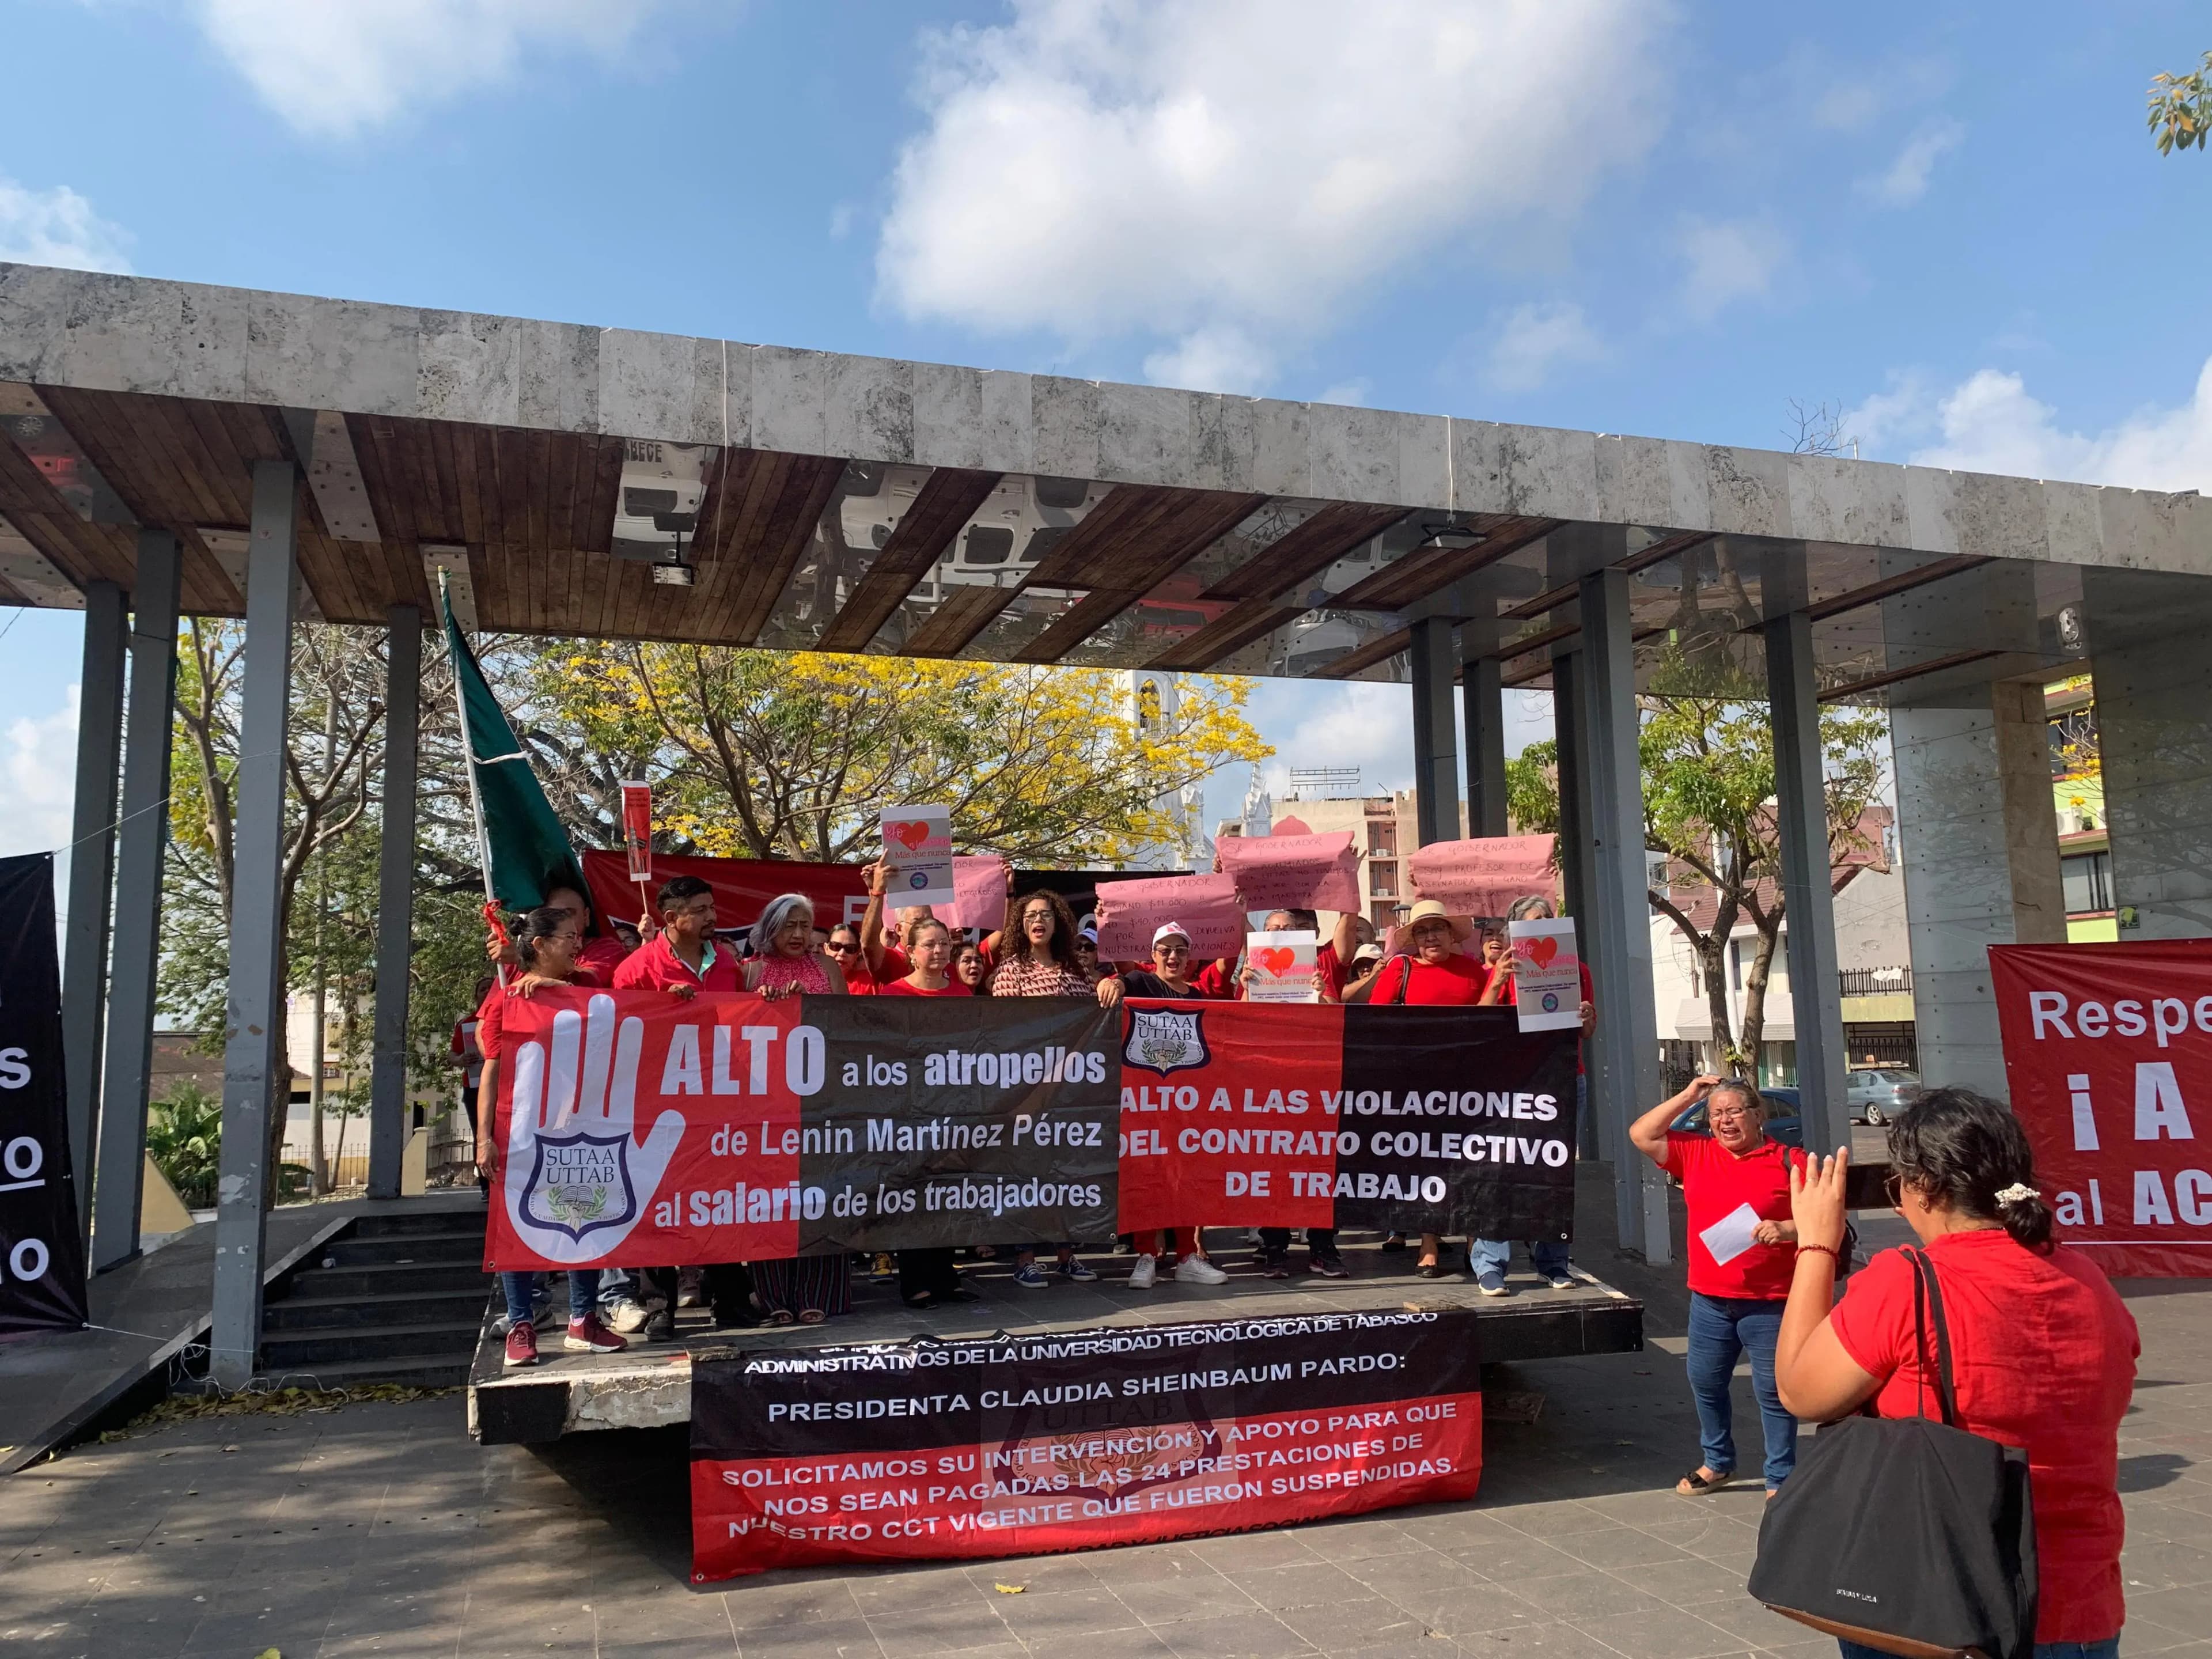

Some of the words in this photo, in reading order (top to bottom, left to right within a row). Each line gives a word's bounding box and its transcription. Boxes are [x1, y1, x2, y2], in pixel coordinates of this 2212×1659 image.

[912, 851, 925, 859] que
[1255, 837, 1322, 855] GOBERNADOR
[1448, 841, 1527, 855] GOBERNADOR
[1455, 863, 1508, 874] PROFESOR
[1520, 862, 1536, 870] DE
[1137, 878, 1213, 893] GOBERNADOR
[1116, 933, 1135, 942] POR
[1105, 944, 1153, 955] NUESTRAS
[1190, 941, 1236, 952] TACIONES
[1260, 978, 1276, 986] Más
[1527, 969, 1541, 978] Más
[1543, 969, 1556, 979] que
[1138, 1015, 1194, 1028] SUTAA
[1138, 1027, 1192, 1040] UTTAB
[660, 1024, 825, 1096] ALTO
[842, 1062, 859, 1086] a
[867, 1054, 908, 1086] los
[925, 1046, 1105, 1089] atropellos
[1120, 1085, 1199, 1113] ALTO
[1209, 1086, 1233, 1112] A
[1243, 1088, 1309, 1114] LAS
[1320, 1090, 1558, 1122] VIOLACIONES
[711, 1123, 748, 1156] de
[761, 1119, 853, 1155] Lenin
[867, 1116, 1004, 1152] Martínez
[1013, 1113, 1102, 1147] Pérez
[1178, 1127, 1361, 1156] CONTRATO
[1370, 1131, 1569, 1168] COLECTIVO
[546, 1148, 616, 1166] SUTAA
[546, 1166, 614, 1184] UTTAB
[1225, 1171, 1271, 1198] DE
[1289, 1171, 1446, 1204] TRABAJO
[654, 1192, 680, 1228] al
[688, 1182, 825, 1226] salario
[832, 1184, 867, 1218] de
[876, 1184, 916, 1215] los
[925, 1177, 1101, 1217] trabajadores
[2055, 1179, 2104, 1226] al
[745, 1349, 950, 1374] ADMINISTRATIVOS
[954, 1349, 986, 1365] DE
[989, 1347, 1018, 1363] LA
[1021, 1334, 1162, 1361] UNIVERSIDAD
[1314, 1318, 1341, 1333] DE
[1343, 1312, 1438, 1329] TABASCO
[768, 1394, 971, 1422] PRESIDENTA
[980, 1381, 1113, 1409] CLAUDIA
[1122, 1363, 1292, 1396] SHEINBAUM
[1301, 1352, 1406, 1379] PARDO:
[722, 1459, 927, 1487] SOLICITAMOS
[937, 1454, 975, 1475] SU
[985, 1430, 1192, 1469] INTERVENCIÓN
[1200, 1427, 1218, 1445] Y
[1226, 1418, 1320, 1442] APOYO
[1328, 1410, 1398, 1433] PARA
[1406, 1403, 1457, 1424] QUE
[764, 1495, 828, 1517] NOS
[839, 1488, 918, 1513] SEAN
[928, 1473, 1069, 1504] PAGADAS
[1080, 1467, 1132, 1488] LAS
[1142, 1464, 1171, 1482] 24
[1180, 1440, 1386, 1477] PRESTACIONES
[1392, 1433, 1423, 1452] DE
[729, 1517, 873, 1541] NUESTRO
[881, 1517, 940, 1538] CCT
[950, 1502, 1073, 1532] VIGENTE
[1082, 1494, 1141, 1517] QUE
[1151, 1480, 1262, 1510] FUERON
[1271, 1457, 1459, 1495] SUSPENDIDAS.
